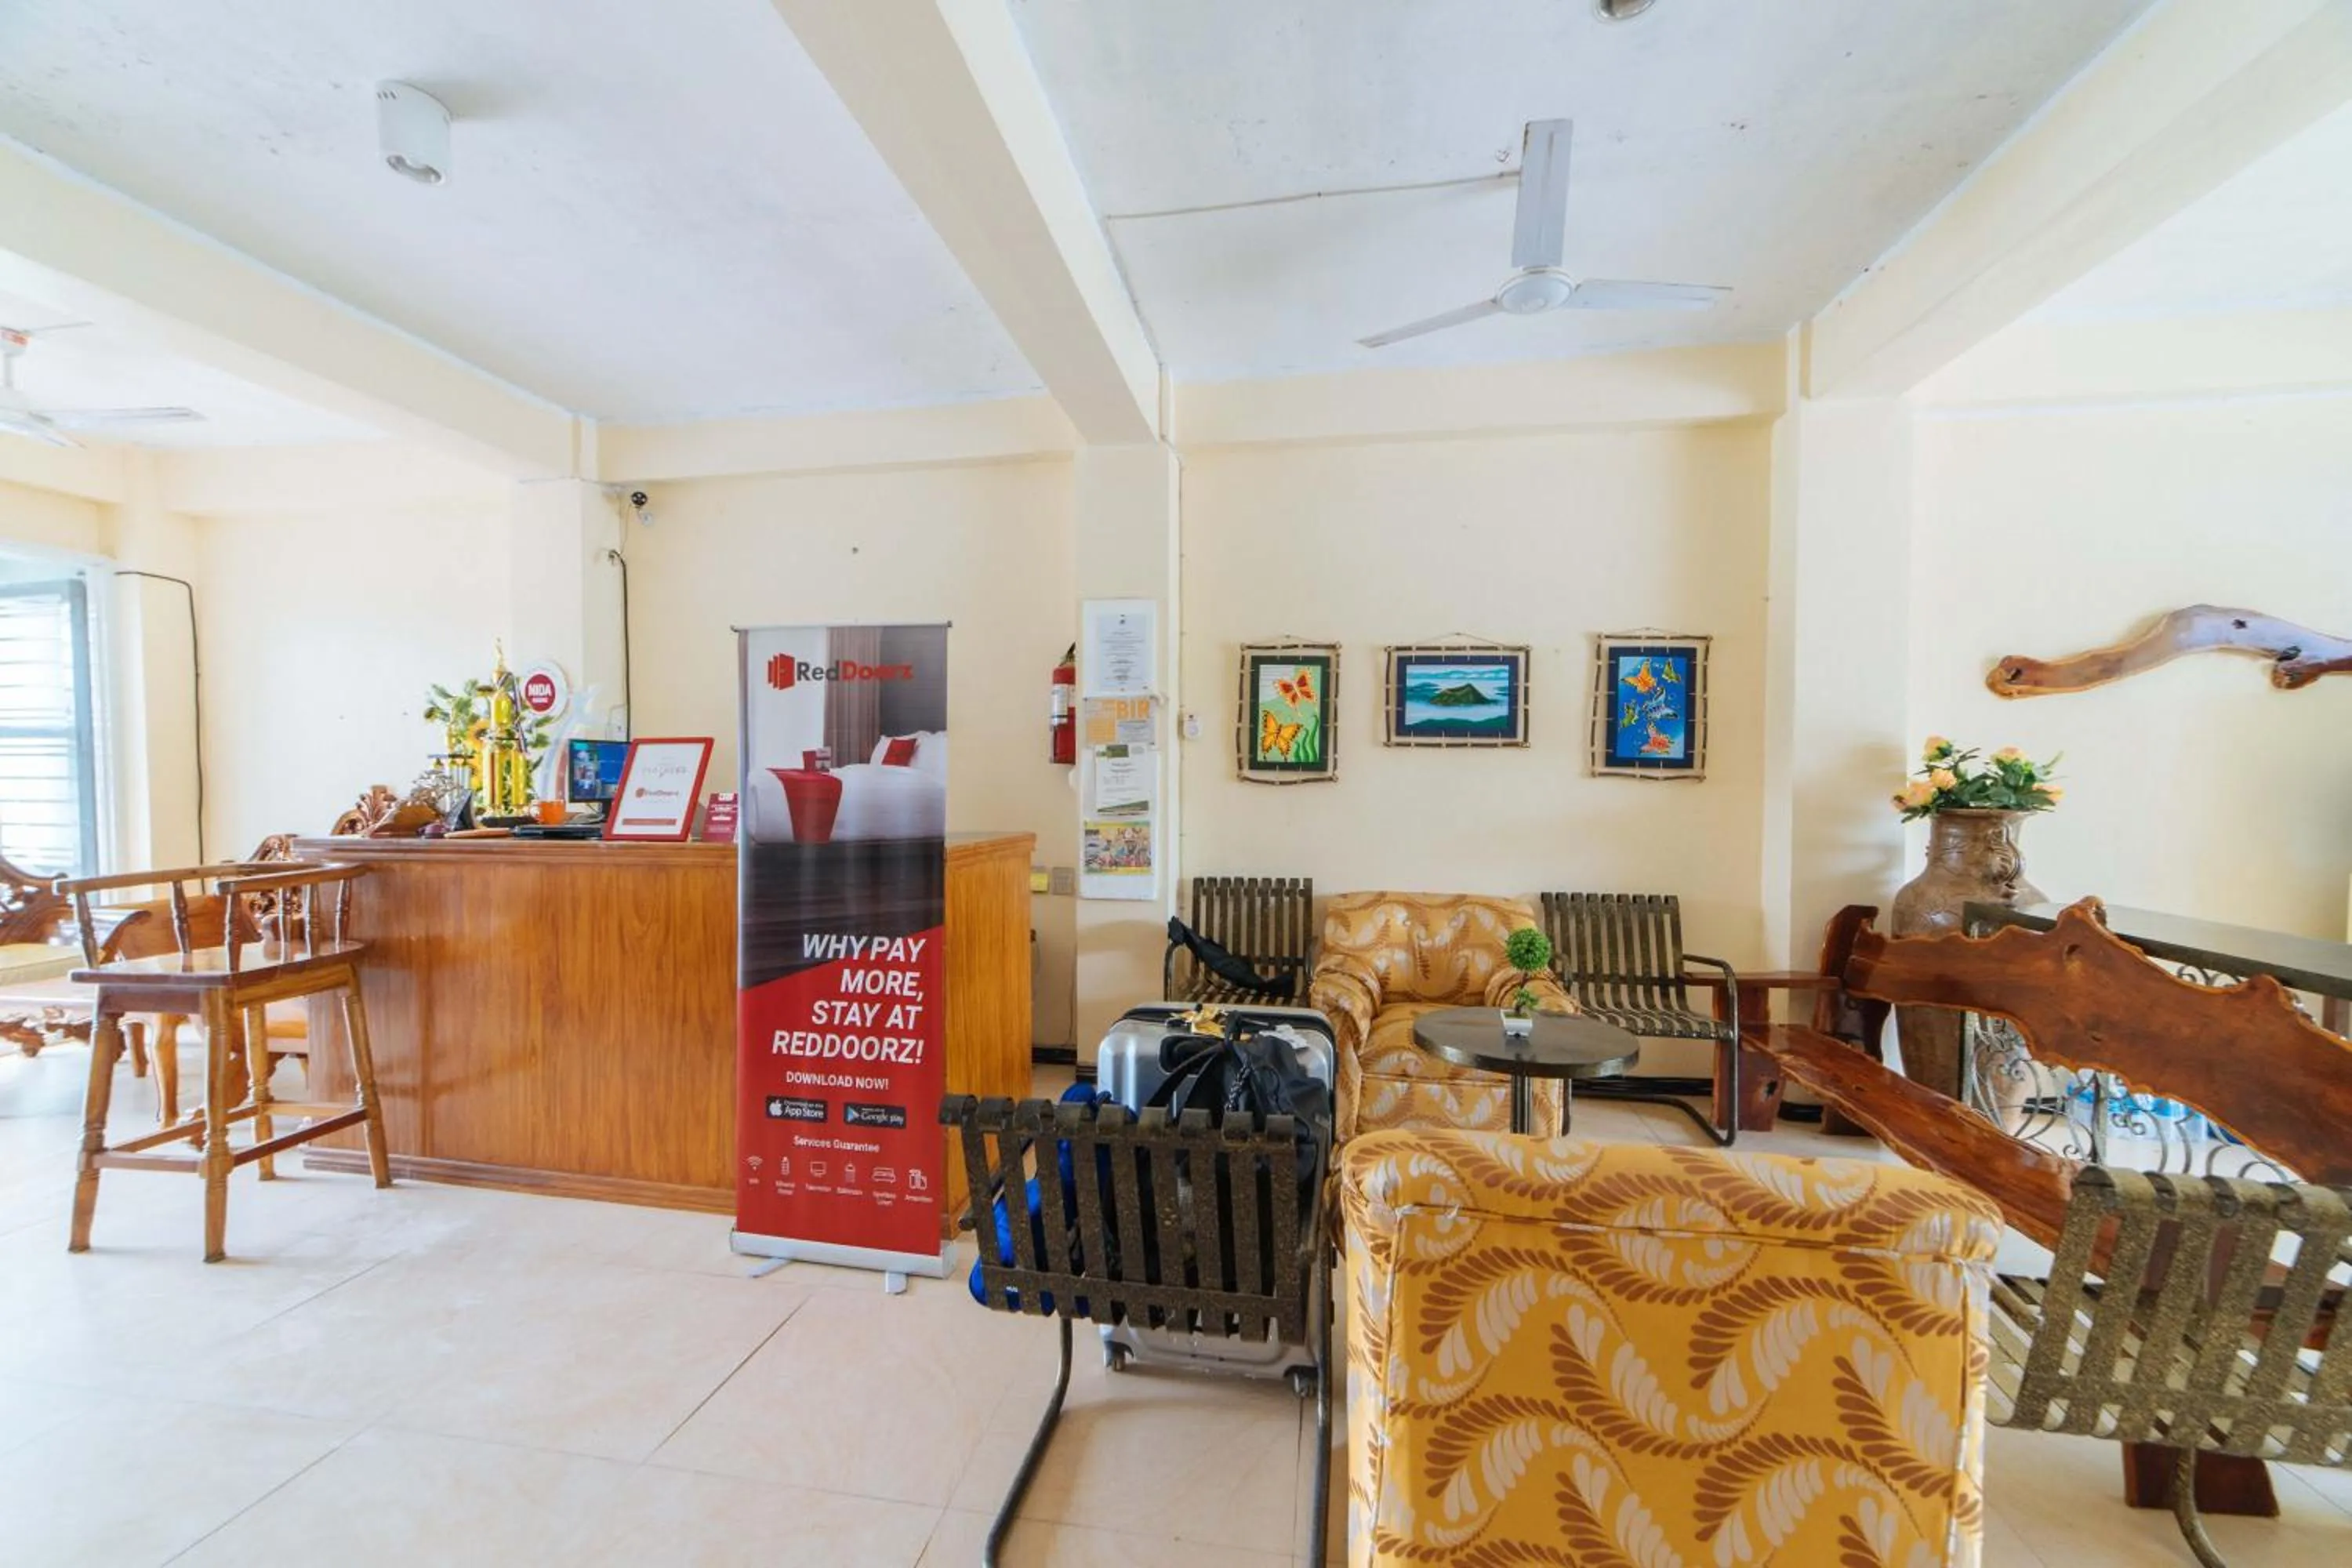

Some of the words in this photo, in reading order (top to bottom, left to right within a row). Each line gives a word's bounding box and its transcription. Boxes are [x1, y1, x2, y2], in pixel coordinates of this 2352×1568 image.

[803, 934, 868, 960] WHY
[869, 937, 927, 963] PAY
[840, 968, 924, 1003] MORE,
[811, 1000, 880, 1028] STAY
[884, 1004, 924, 1030] AT
[772, 1030, 924, 1064] REDDOORZ!
[786, 1071, 853, 1087] DOWNLOAD
[855, 1077, 889, 1090] NOW!
[784, 1106, 802, 1117] App
[802, 1107, 824, 1118] Store
[861, 1111, 888, 1123] Google
[833, 1139, 880, 1152] Guarantee
